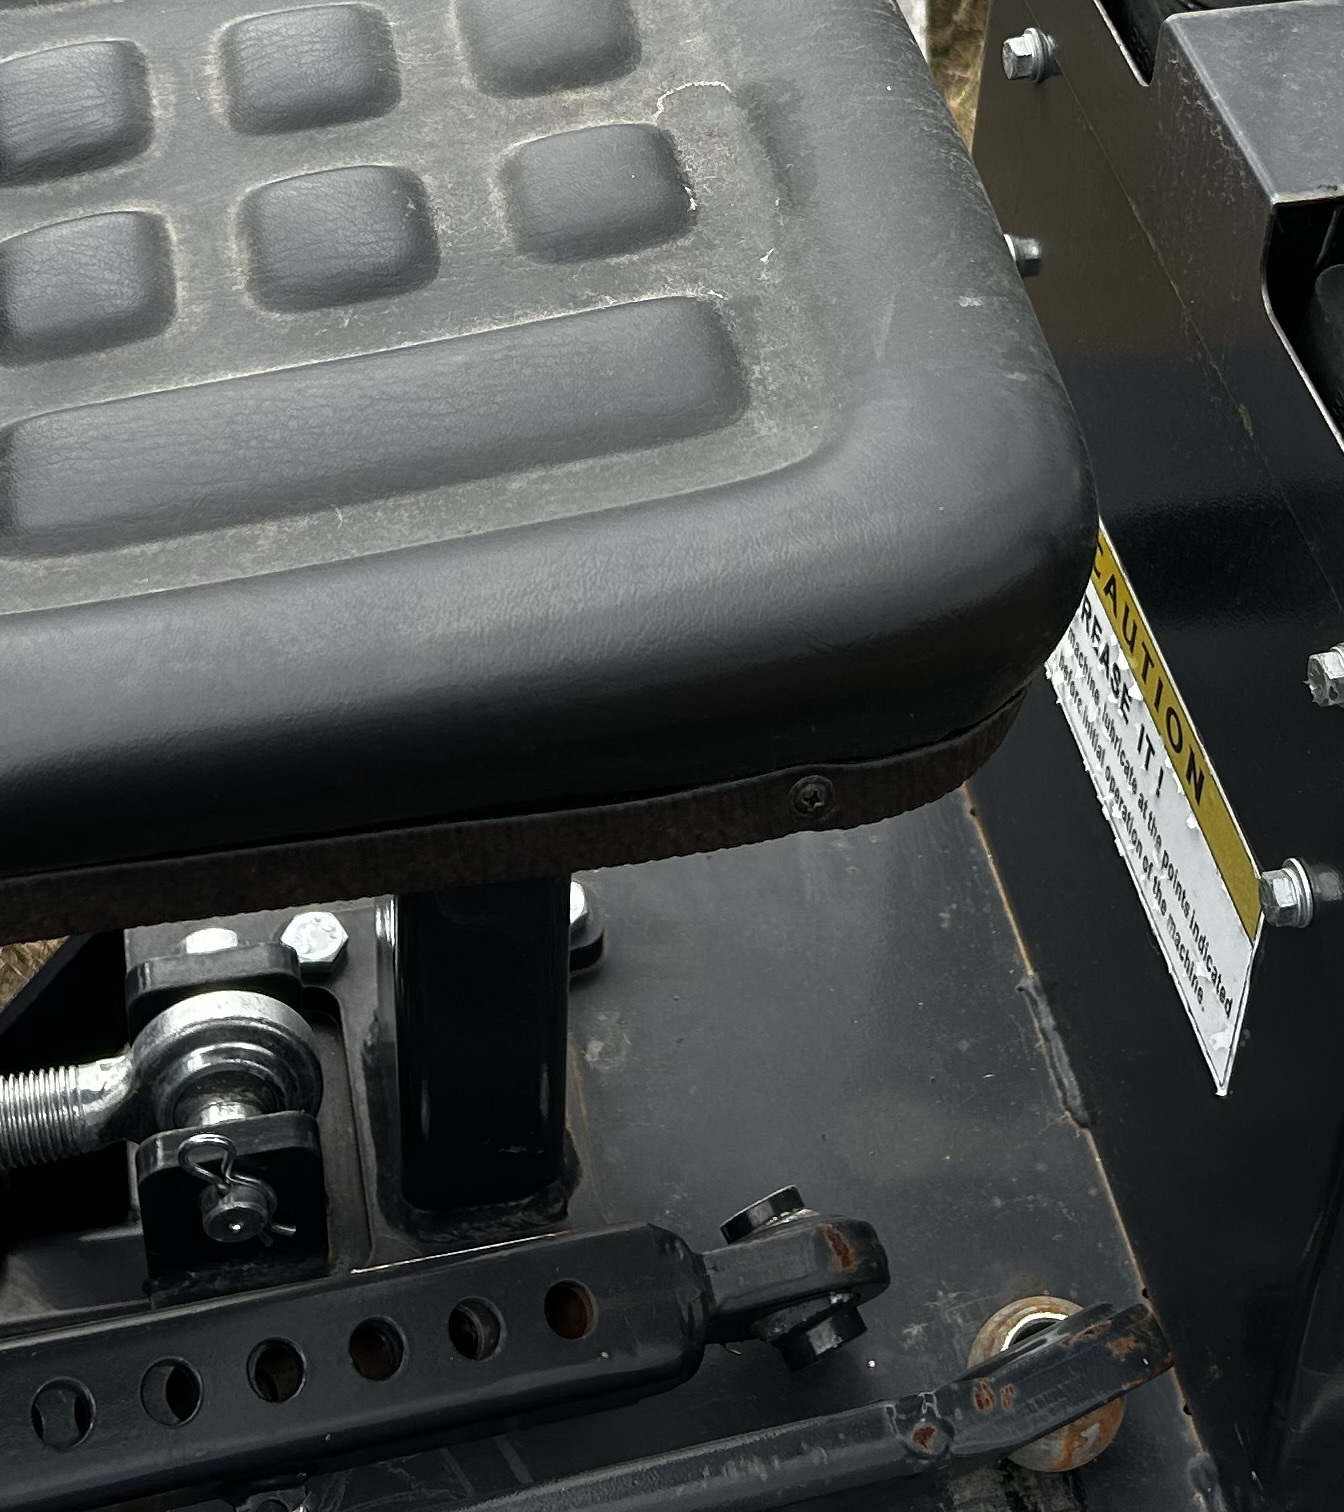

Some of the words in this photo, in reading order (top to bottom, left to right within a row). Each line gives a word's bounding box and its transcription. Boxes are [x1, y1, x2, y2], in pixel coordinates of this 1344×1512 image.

[1081, 594, 1132, 726] REASE
[1136, 723, 1156, 772] IT
[1083, 705, 1106, 769] initial
[1104, 765, 1143, 860] operation
[1142, 854, 1154, 880] of
[1153, 875, 1168, 917] the
[1166, 913, 1206, 1012] machine.
[1102, 702, 1138, 795] lubricate
[1138, 793, 1147, 820] at
[1147, 810, 1163, 850] the
[1162, 850, 1191, 919] points
[1189, 910, 1234, 1019] indicated
